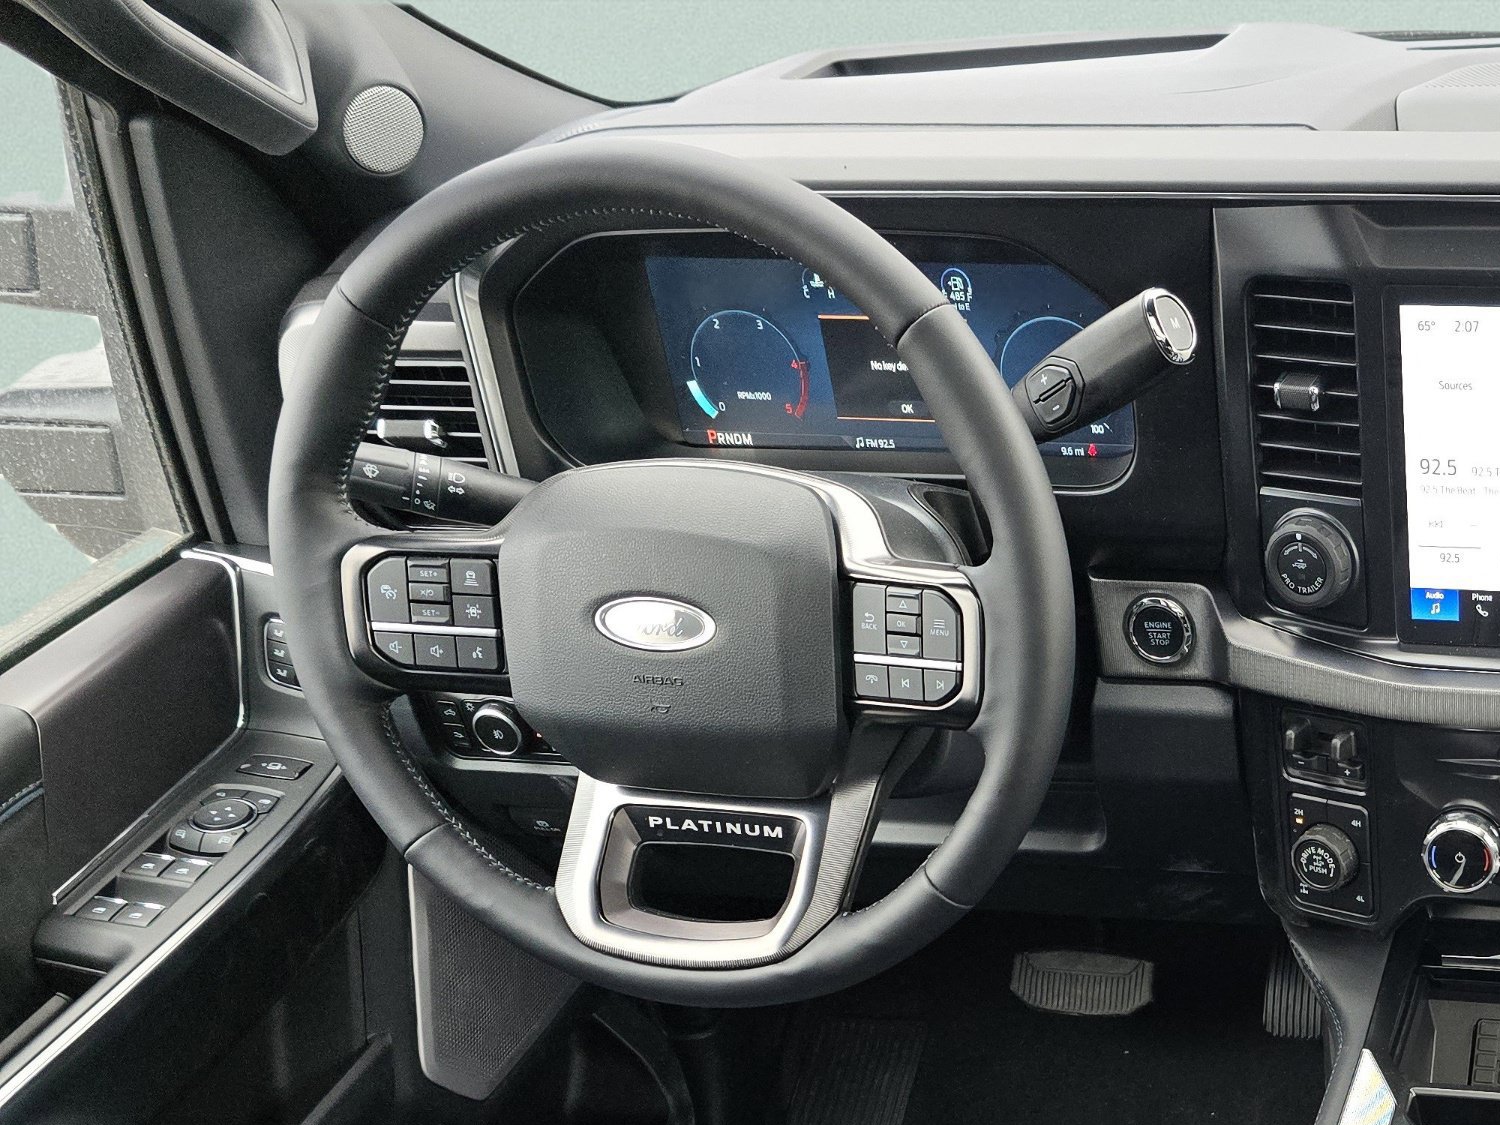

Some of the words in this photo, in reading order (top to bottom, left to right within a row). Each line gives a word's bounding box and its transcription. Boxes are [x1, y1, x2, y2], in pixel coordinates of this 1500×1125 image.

[950, 292, 964, 300] 485
[712, 318, 720, 330] 2
[756, 320, 764, 330] 3
[1416, 320, 1436, 332] 65°
[694, 356, 700, 368] 1
[791, 360, 798, 369] 4
[870, 360, 882, 371] No
[882, 360, 896, 372] key
[1438, 380, 1474, 392] Sources
[718, 402, 726, 412] 0
[785, 404, 793, 414] 5
[900, 404, 914, 414] OK
[1090, 424, 1105, 434] 100
[866, 440, 879, 449] FM
[879, 440, 896, 449] 92.5
[1060, 446, 1074, 456] 9.6
[1074, 446, 1085, 456] mi
[1420, 458, 1458, 476] 92.5
[1470, 466, 1493, 478] 92.5
[1439, 552, 1460, 564] 92.5
[1280, 572, 1296, 590] PRO
[1296, 576, 1324, 594] TRAILER
[1425, 591, 1446, 600] Audio
[1472, 592, 1494, 602] Phone
[860, 622, 878, 631] BACK
[896, 620, 906, 628] OK
[1144, 621, 1172, 630] ENGINE
[930, 628, 950, 638] MENU
[1148, 632, 1172, 640] START
[1150, 638, 1171, 646] STOP
[632, 674, 684, 687] AIRBAG
[1294, 808, 1304, 816] 2H
[648, 816, 784, 839] PLATINUM
[1350, 819, 1362, 828] 4H
[1300, 846, 1317, 865] DRIVE
[1316, 848, 1336, 870] MODE
[1308, 864, 1328, 876] PUSH
